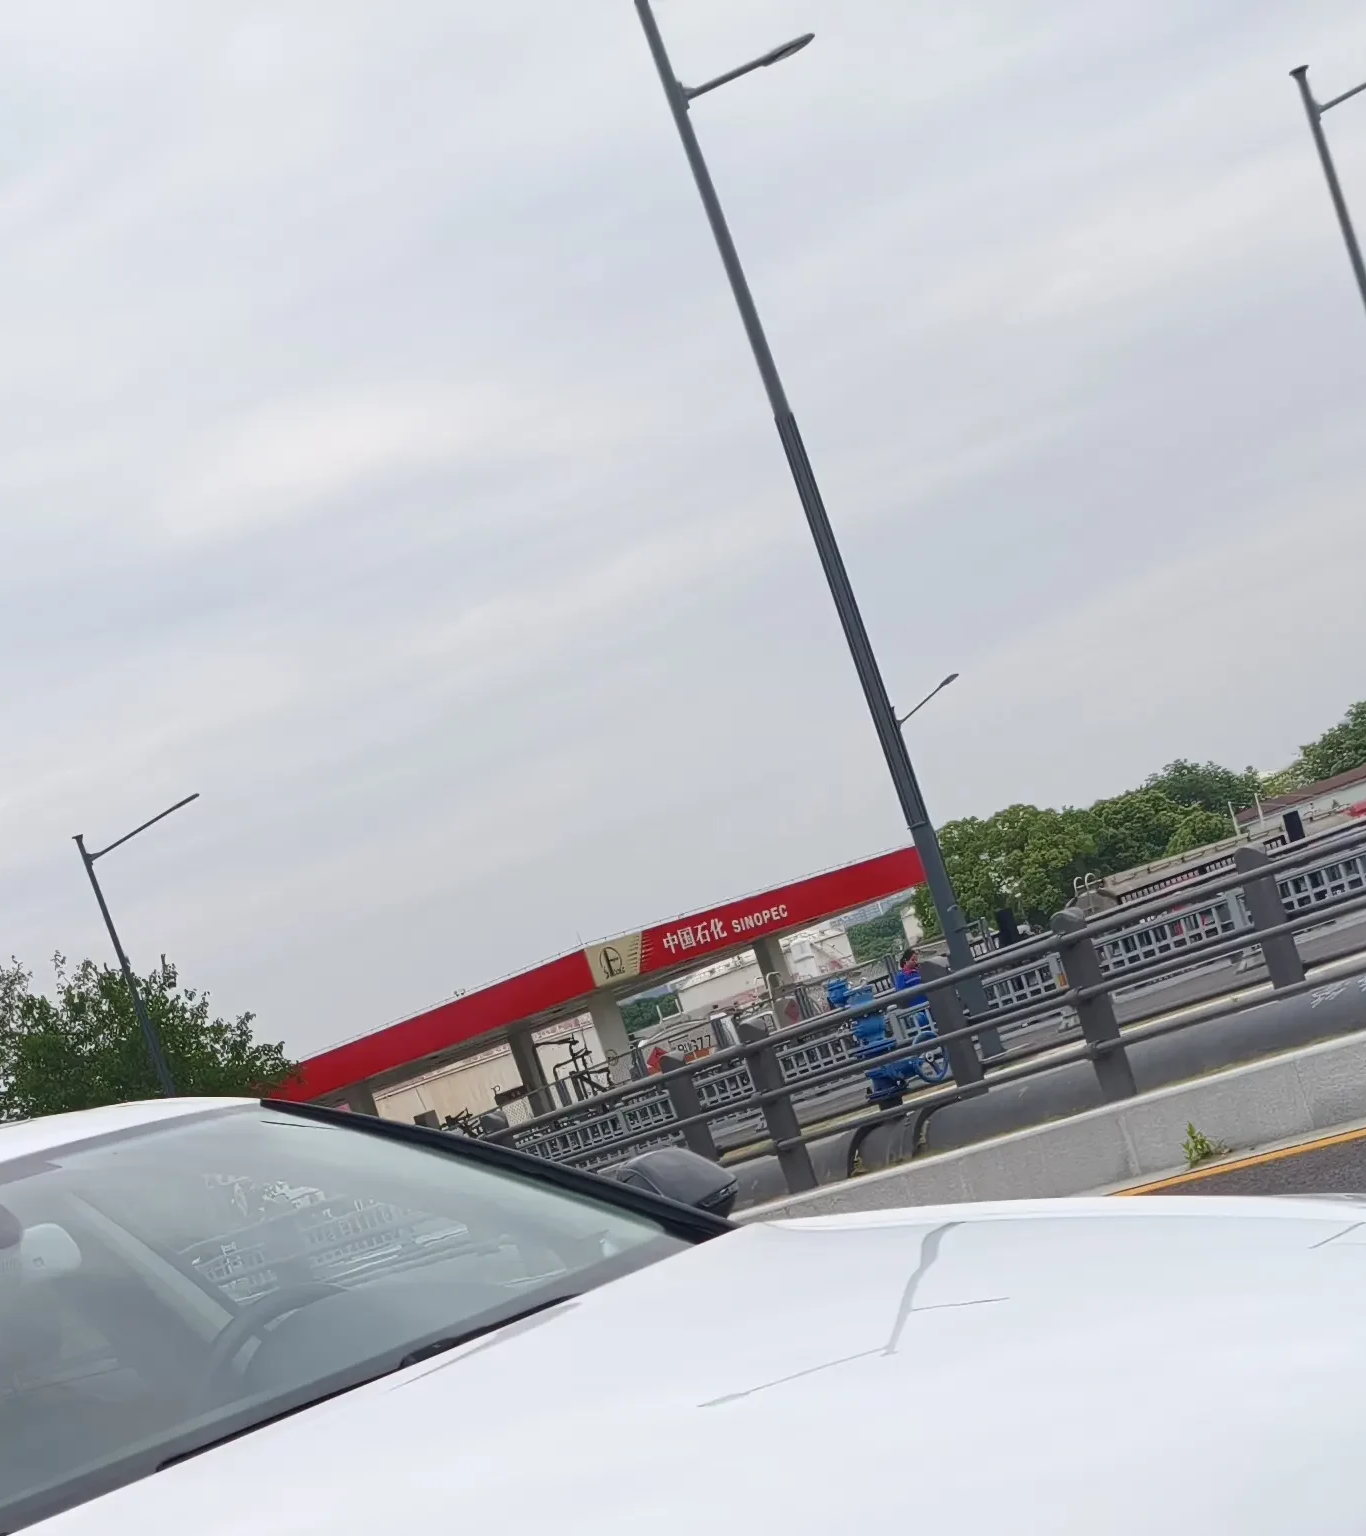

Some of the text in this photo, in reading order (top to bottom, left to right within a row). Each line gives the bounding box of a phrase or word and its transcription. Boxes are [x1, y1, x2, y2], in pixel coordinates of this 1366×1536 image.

[662, 904, 788, 954] 中国石化 SINOPEC
